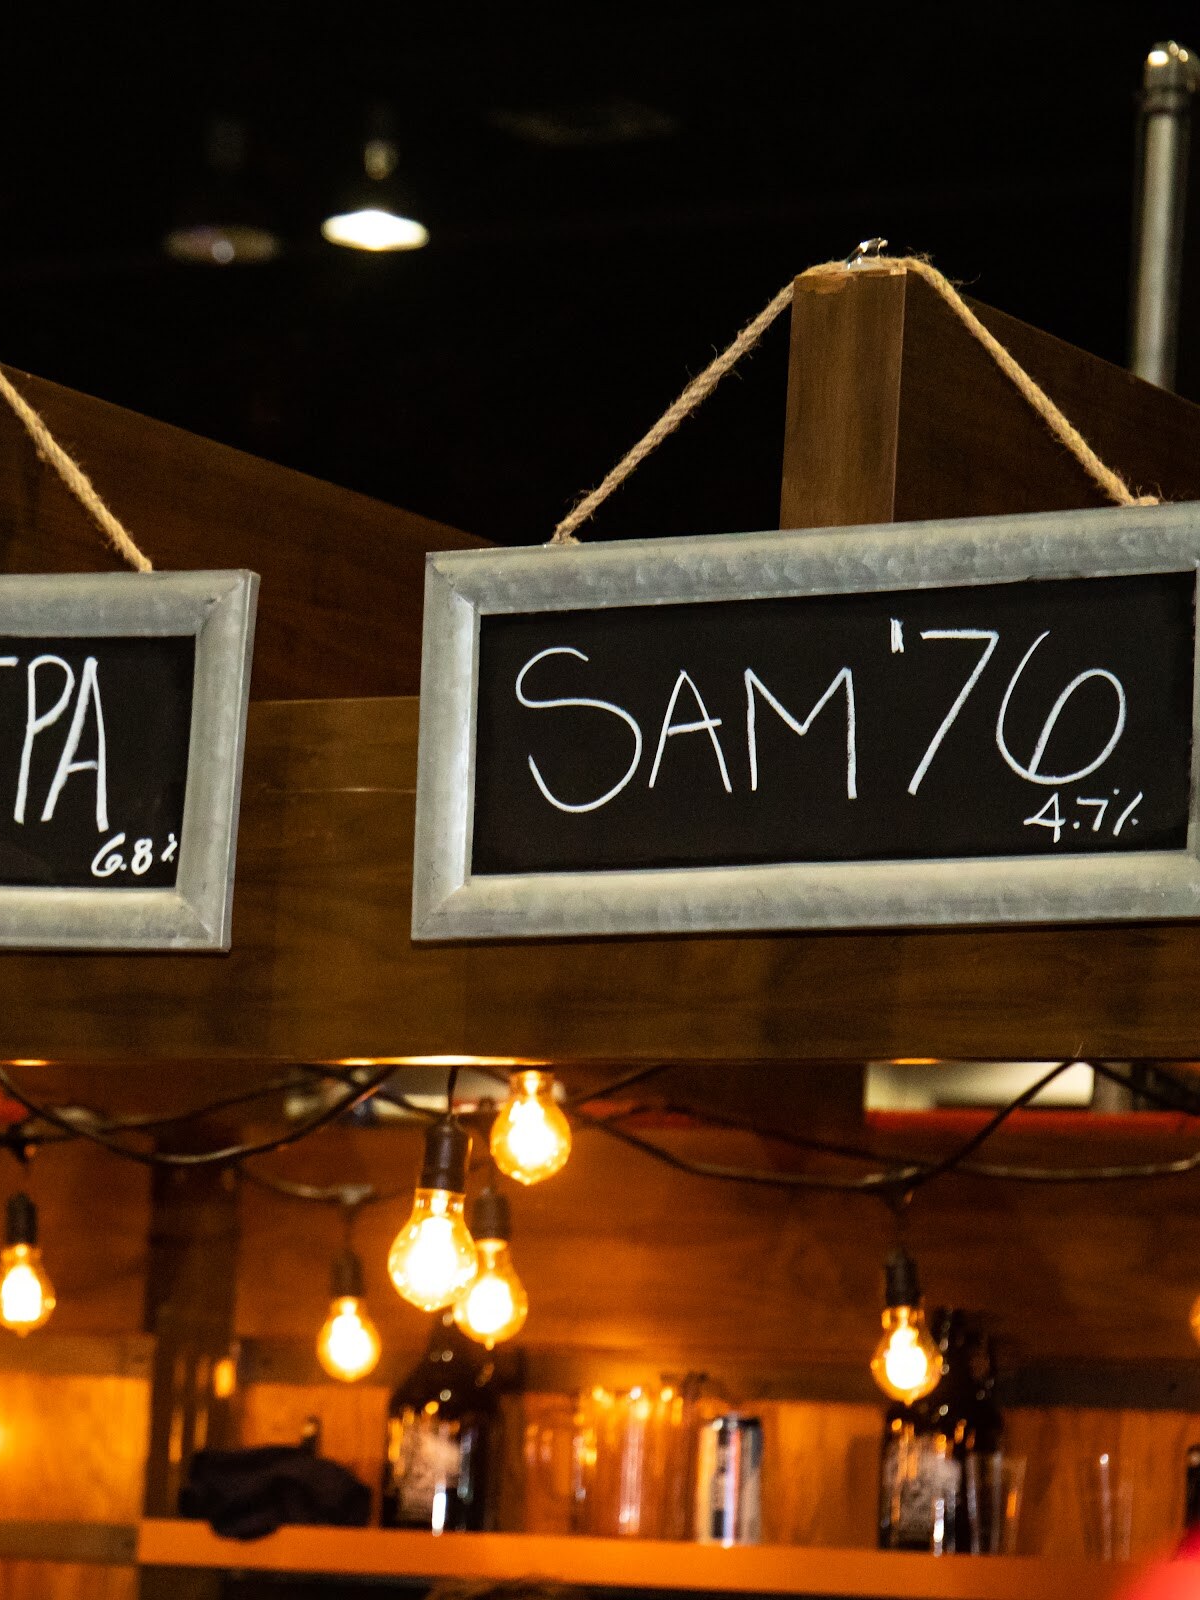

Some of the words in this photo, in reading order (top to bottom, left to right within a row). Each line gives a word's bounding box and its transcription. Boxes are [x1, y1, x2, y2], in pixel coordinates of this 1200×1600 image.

[515, 646, 859, 814] SAM
[889, 617, 1127, 796] '76
[1022, 787, 1144, 845] 4.7%
[90, 831, 179, 878] 6.8%
